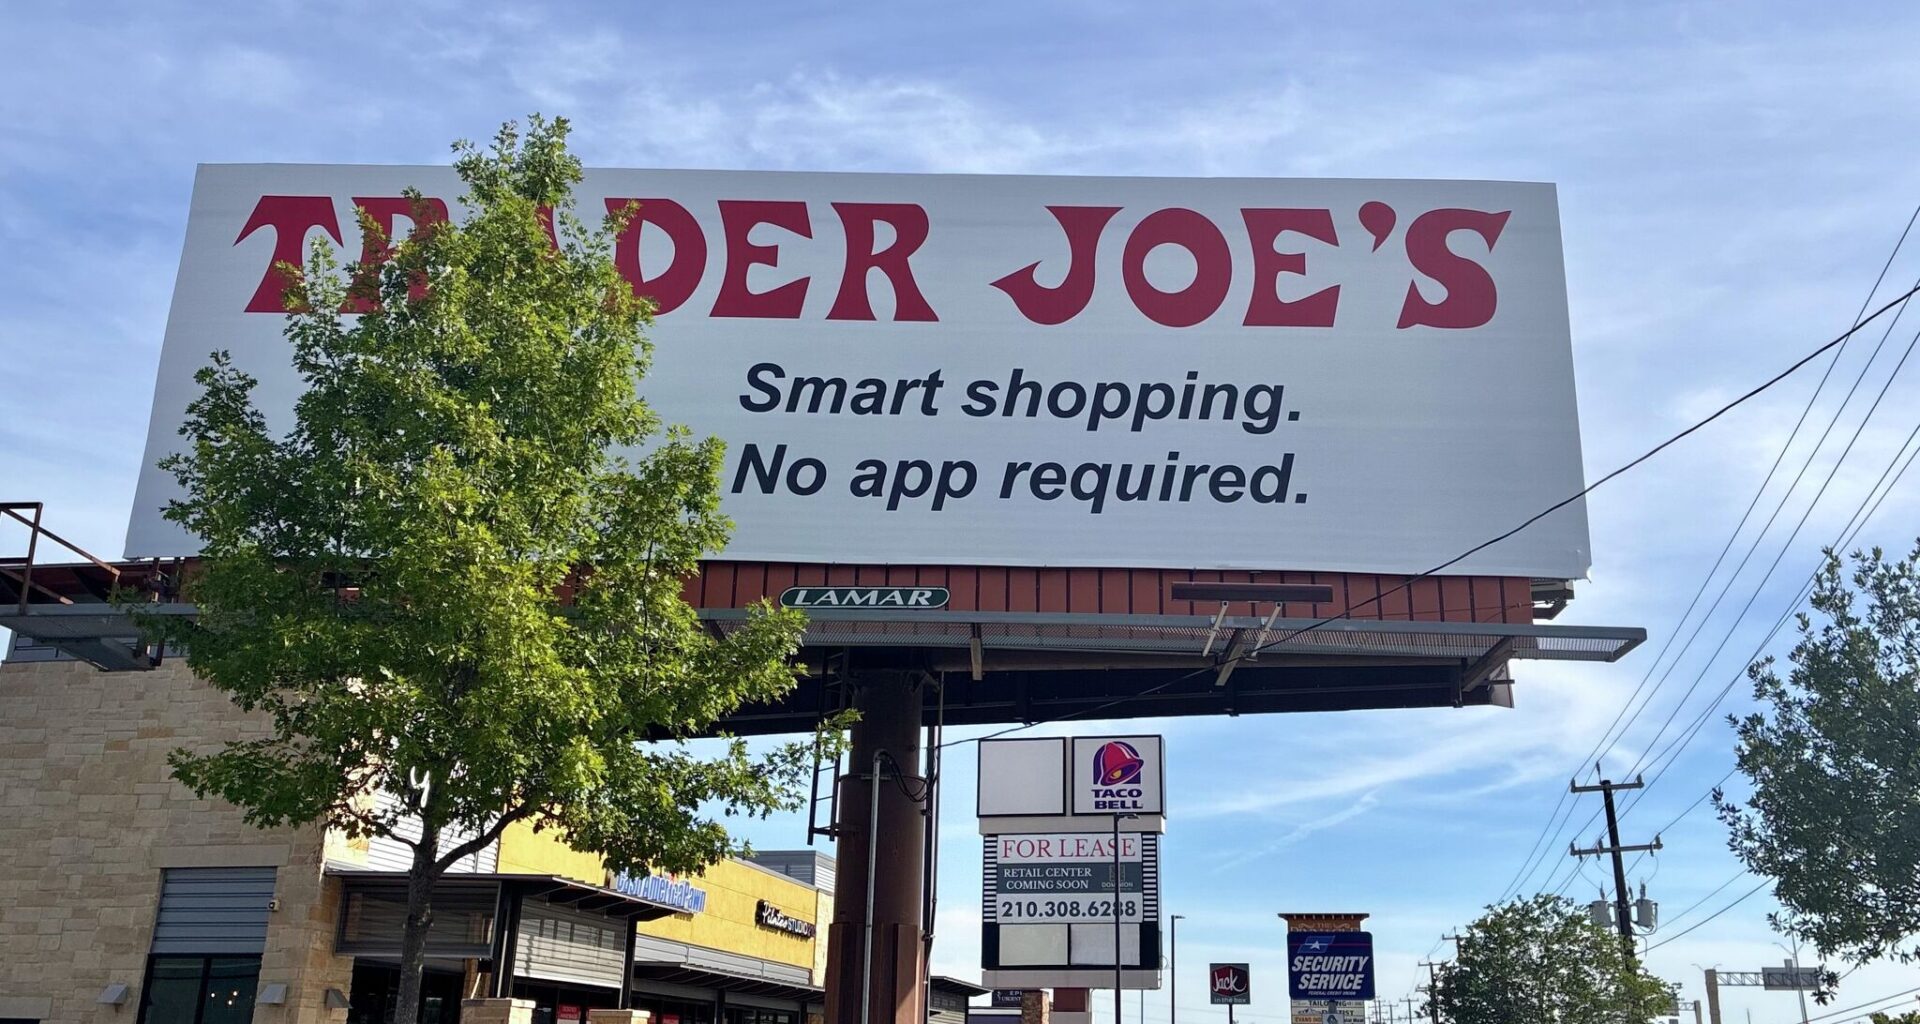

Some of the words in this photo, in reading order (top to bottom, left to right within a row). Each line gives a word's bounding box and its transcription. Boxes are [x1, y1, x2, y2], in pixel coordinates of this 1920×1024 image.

[234, 195, 937, 320] TRDER
[989, 201, 1512, 328] JOE'S
[739, 363, 945, 417] Smart
[961, 369, 1300, 434] shopping.
[731, 444, 827, 496] No
[849, 459, 978, 512] app
[999, 452, 1308, 514] required.
[795, 590, 933, 606] LAMAR
[1091, 788, 1143, 799] TACO
[1094, 800, 1143, 810] BELL
[1002, 839, 1053, 859] FOR
[1060, 838, 1136, 858] LEASE
[1004, 868, 1042, 878] RETAIL
[1045, 867, 1092, 877] CENTER
[1006, 880, 1054, 890] COMING
[1056, 879, 1089, 889] SOON
[1001, 901, 1137, 917] 210.308.6288
[1291, 956, 1369, 972] SECURITY
[1213, 969, 1247, 992] Jack
[1298, 974, 1364, 990] SERVICE
